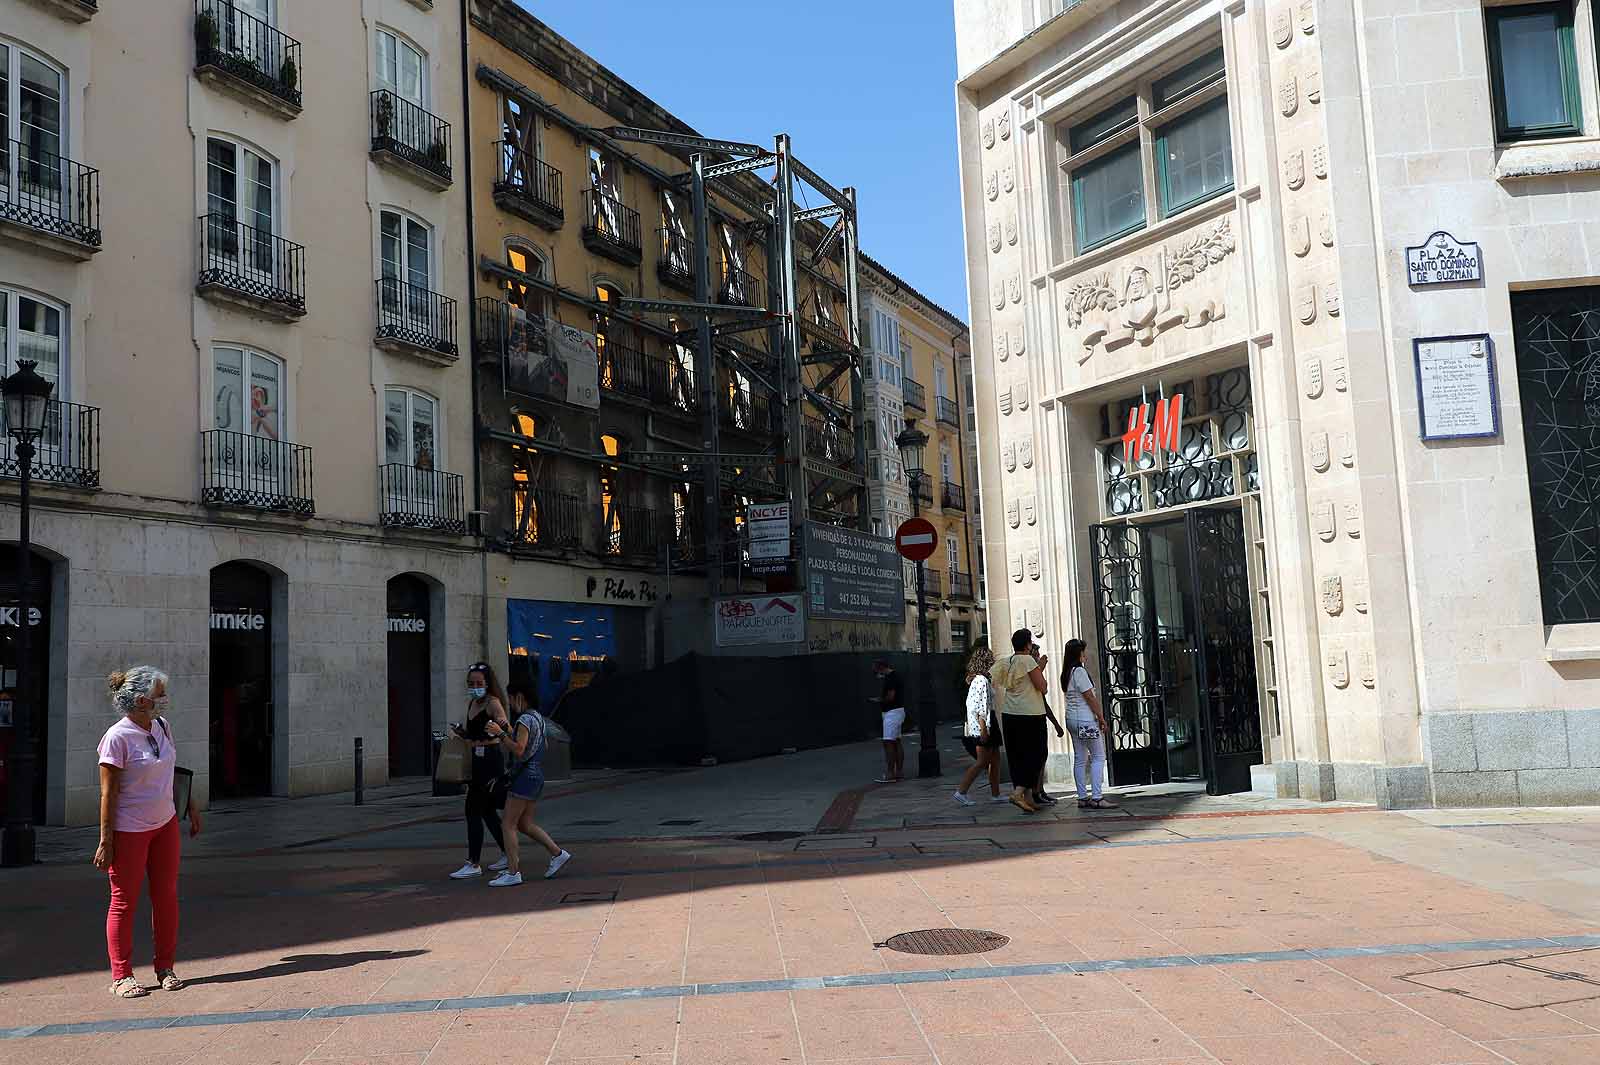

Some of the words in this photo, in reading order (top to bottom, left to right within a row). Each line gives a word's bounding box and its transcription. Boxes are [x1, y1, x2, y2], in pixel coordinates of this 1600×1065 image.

[1420, 248, 1467, 261] PLAZA
[1411, 260, 1437, 272] SANTO
[1440, 257, 1477, 270] DOMINGO
[1416, 272, 1428, 282] DE
[1121, 394, 1183, 463] H&M
[750, 506, 788, 519] INCYE
[811, 527, 840, 543] VIVIENDAS
[840, 535, 848, 545] DE
[854, 537, 858, 546] 3
[836, 547, 878, 564] PERSONALIZADAS
[752, 565, 787, 575] incye.com
[808, 557, 829, 569] PLAZAS
[829, 560, 837, 571] DE
[837, 562, 857, 574] GARAJE
[861, 566, 876, 576] LOCAL
[604, 578, 635, 600] Pilar
[839, 592, 849, 604] 947
[850, 593, 860, 604] 252
[723, 614, 794, 630] PARQUENORTE
